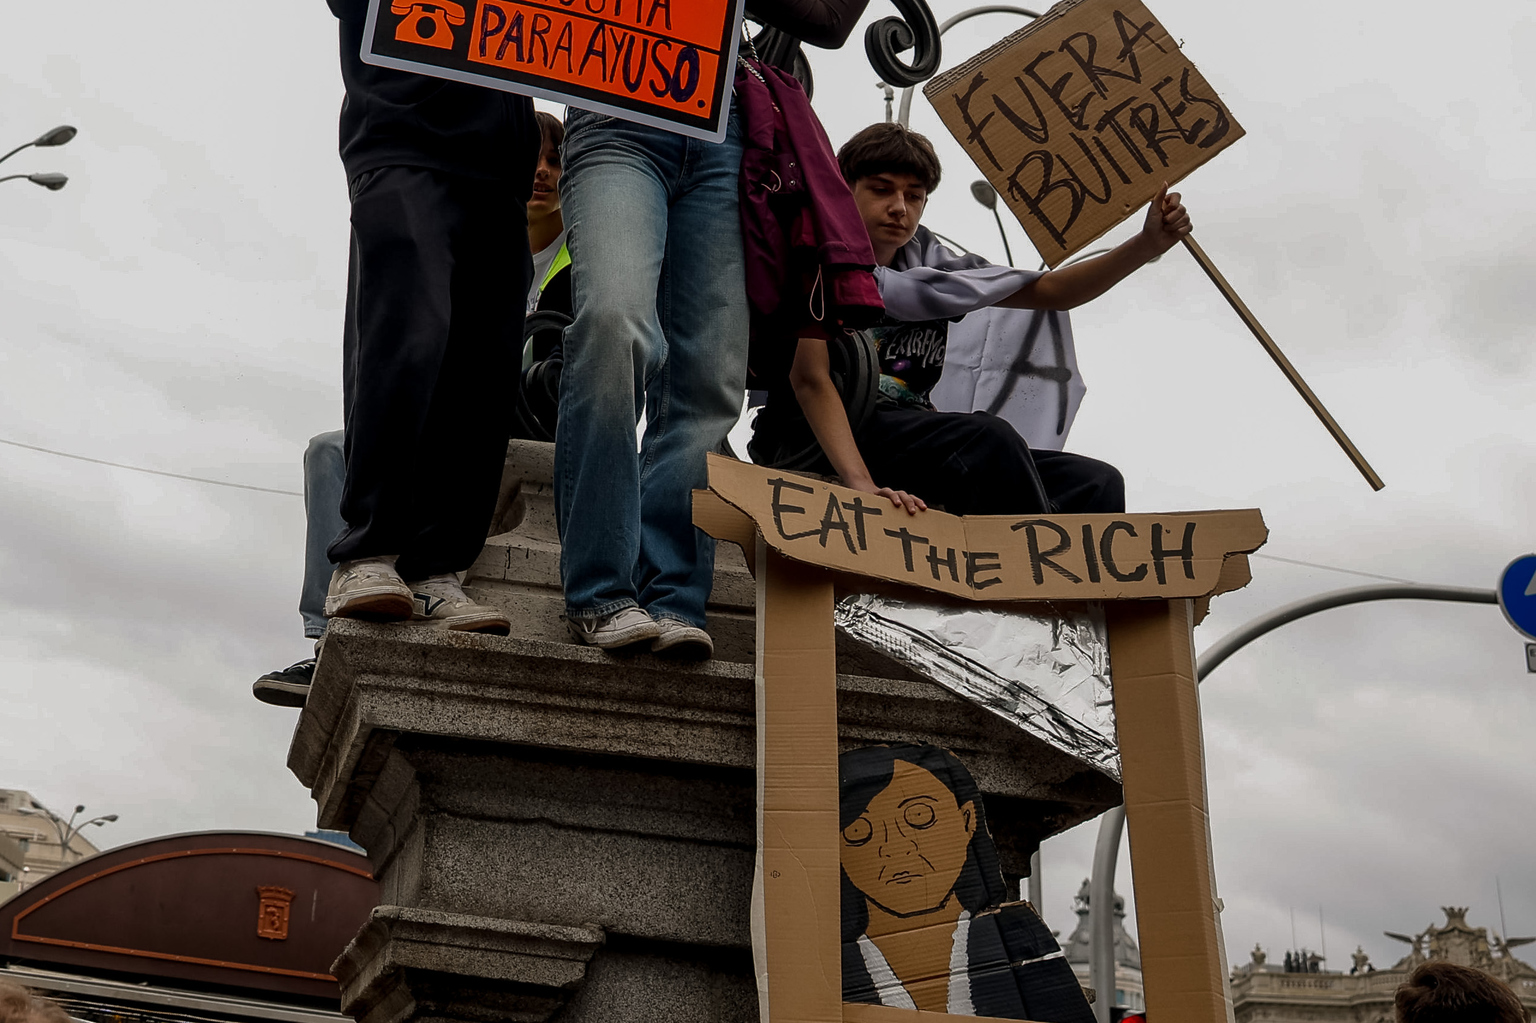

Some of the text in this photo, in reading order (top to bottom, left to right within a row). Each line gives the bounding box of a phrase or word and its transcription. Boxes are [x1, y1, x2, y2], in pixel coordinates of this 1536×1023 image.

[479, 4, 574, 74] PARA
[952, 9, 1168, 172] FUERA
[1006, 67, 1230, 251] BUITRES
[767, 477, 1196, 590] EAT THE RICH
